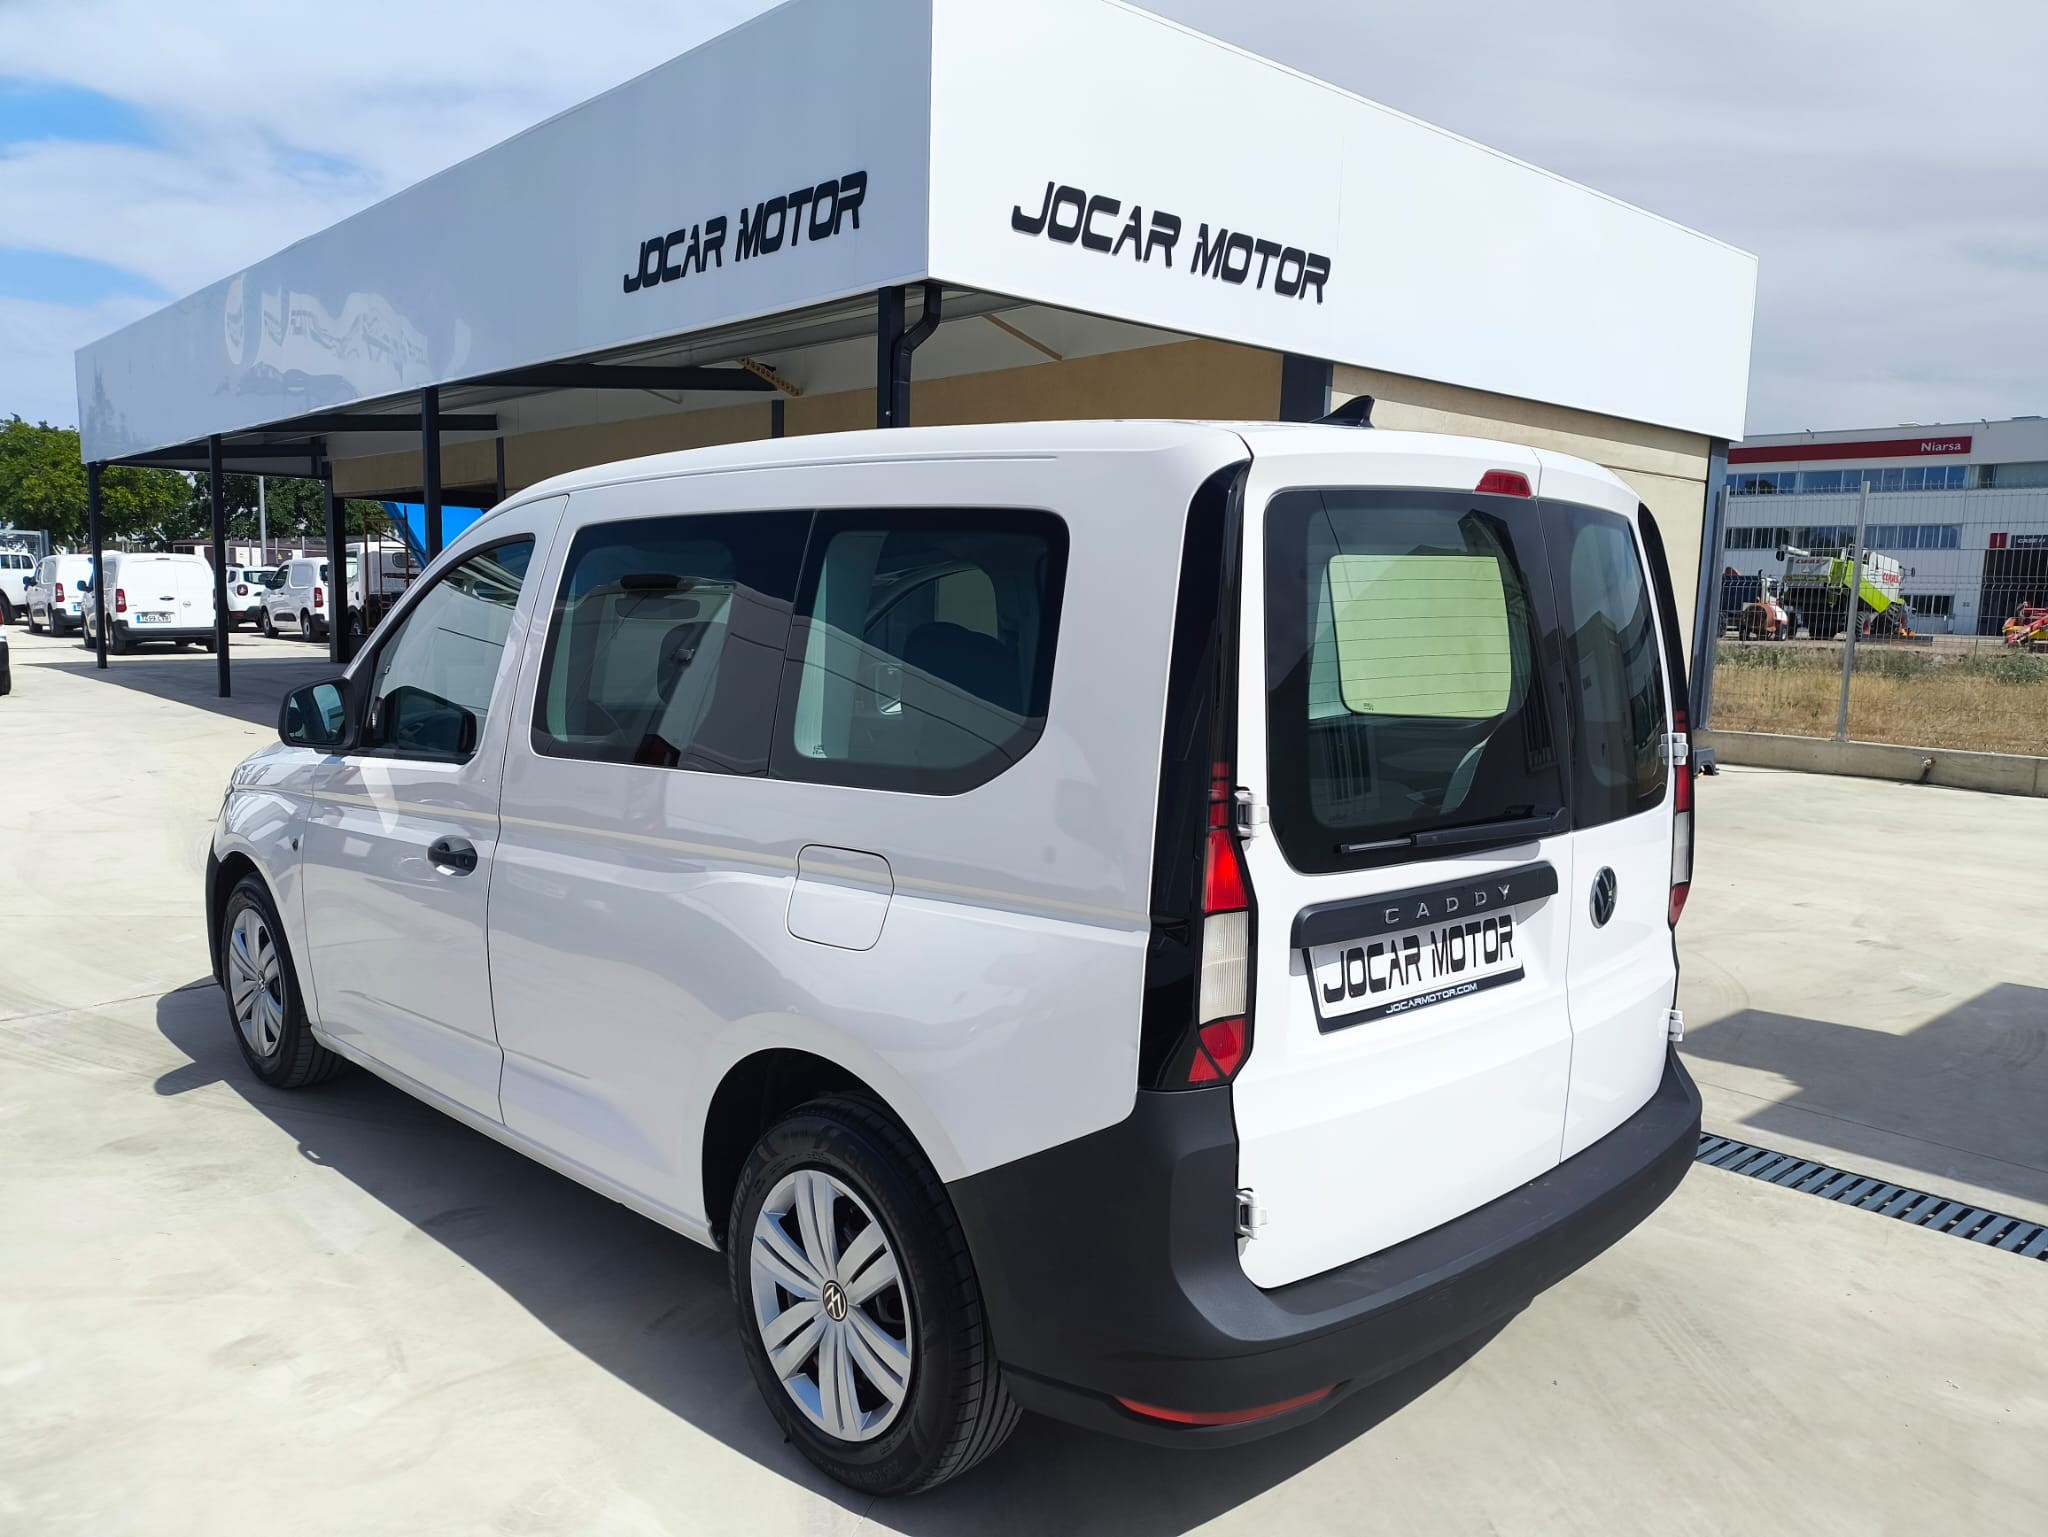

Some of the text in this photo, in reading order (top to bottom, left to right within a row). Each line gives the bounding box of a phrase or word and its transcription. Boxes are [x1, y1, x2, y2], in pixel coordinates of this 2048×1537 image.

[623, 170, 868, 294] JOCAR MOTOR
[1010, 181, 1332, 304] JOCAR MOTOR
[1920, 441, 1961, 452] Niarsa
[1384, 883, 1511, 925] CADDY
[1323, 914, 1514, 1004] JOCAR MOTOR
[1385, 982, 1478, 1014] JOCARMOTOR.COM
